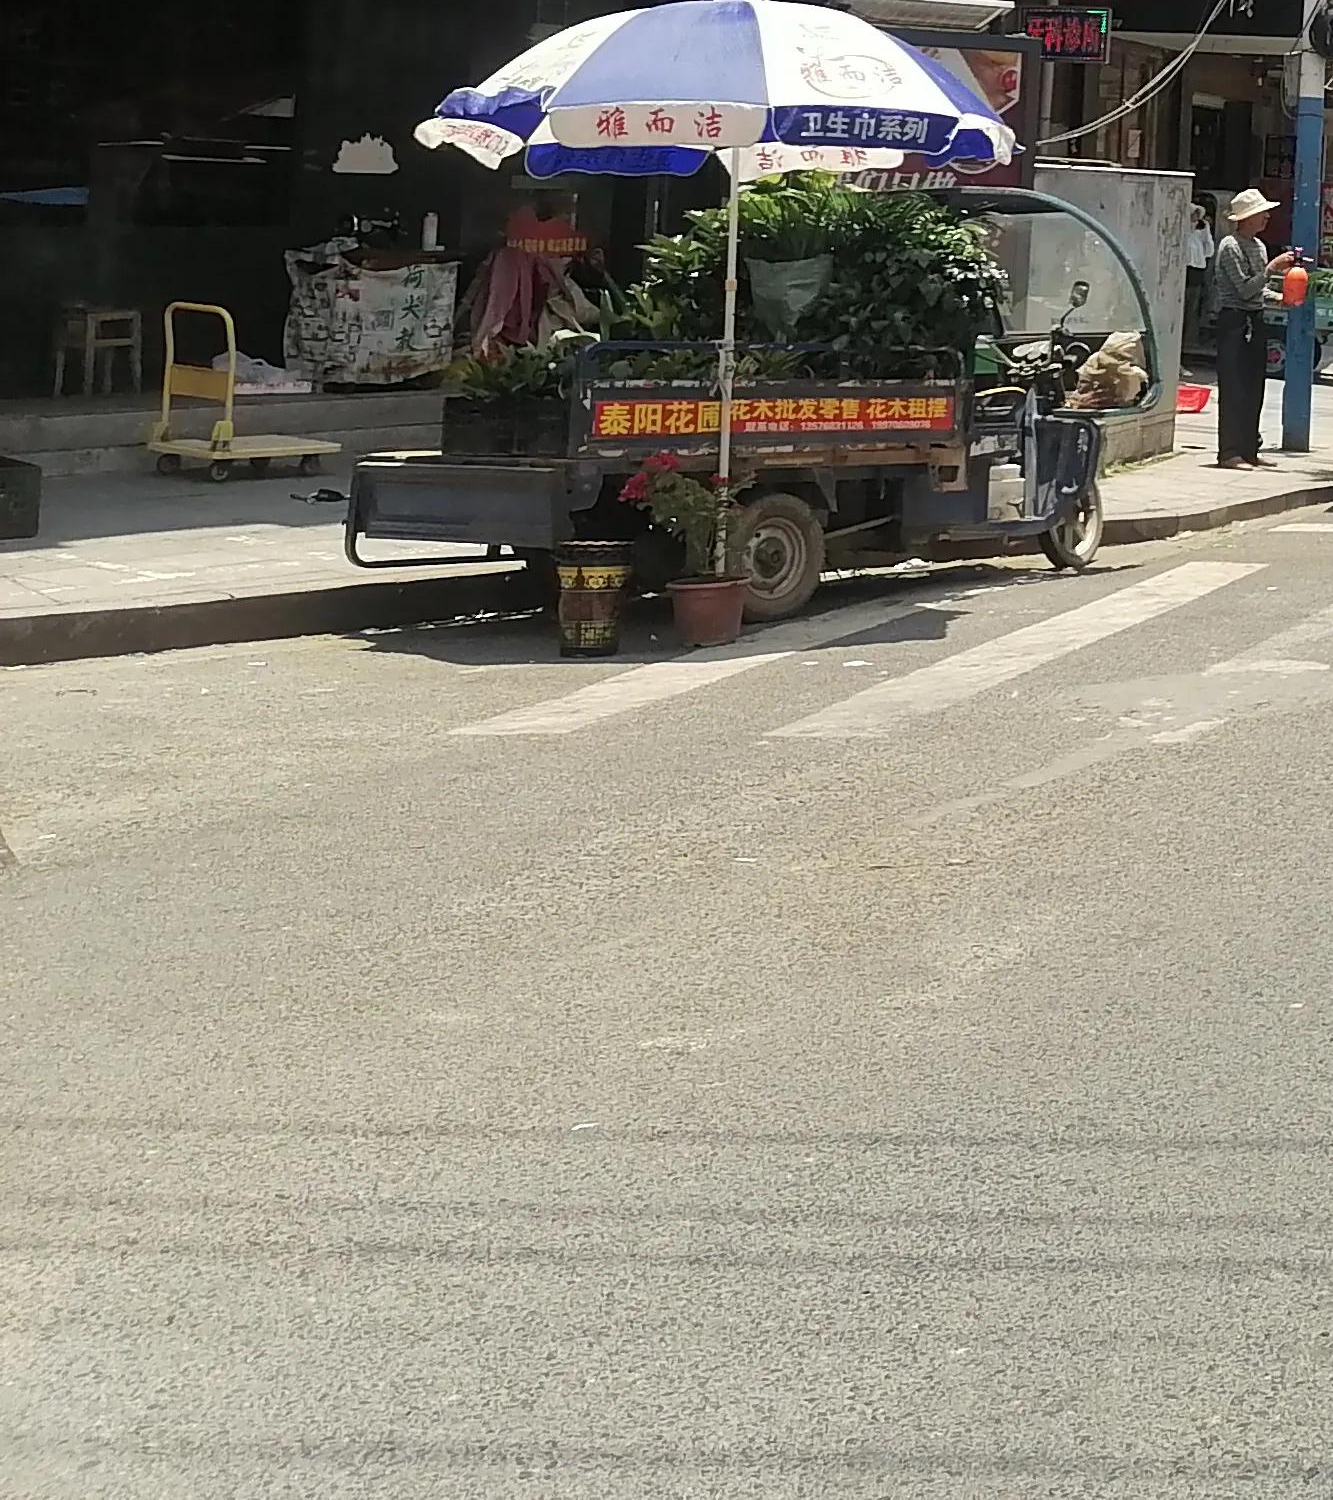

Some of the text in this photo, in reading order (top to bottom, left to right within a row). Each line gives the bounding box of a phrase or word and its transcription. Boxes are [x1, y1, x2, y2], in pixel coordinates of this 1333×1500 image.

[596, 106, 725, 141] 雅而洁
[801, 112, 929, 144] 卫生巾系列
[599, 403, 721, 436] 泰阳花圃
[731, 397, 947, 420] 花木批发零售 花木租摆
